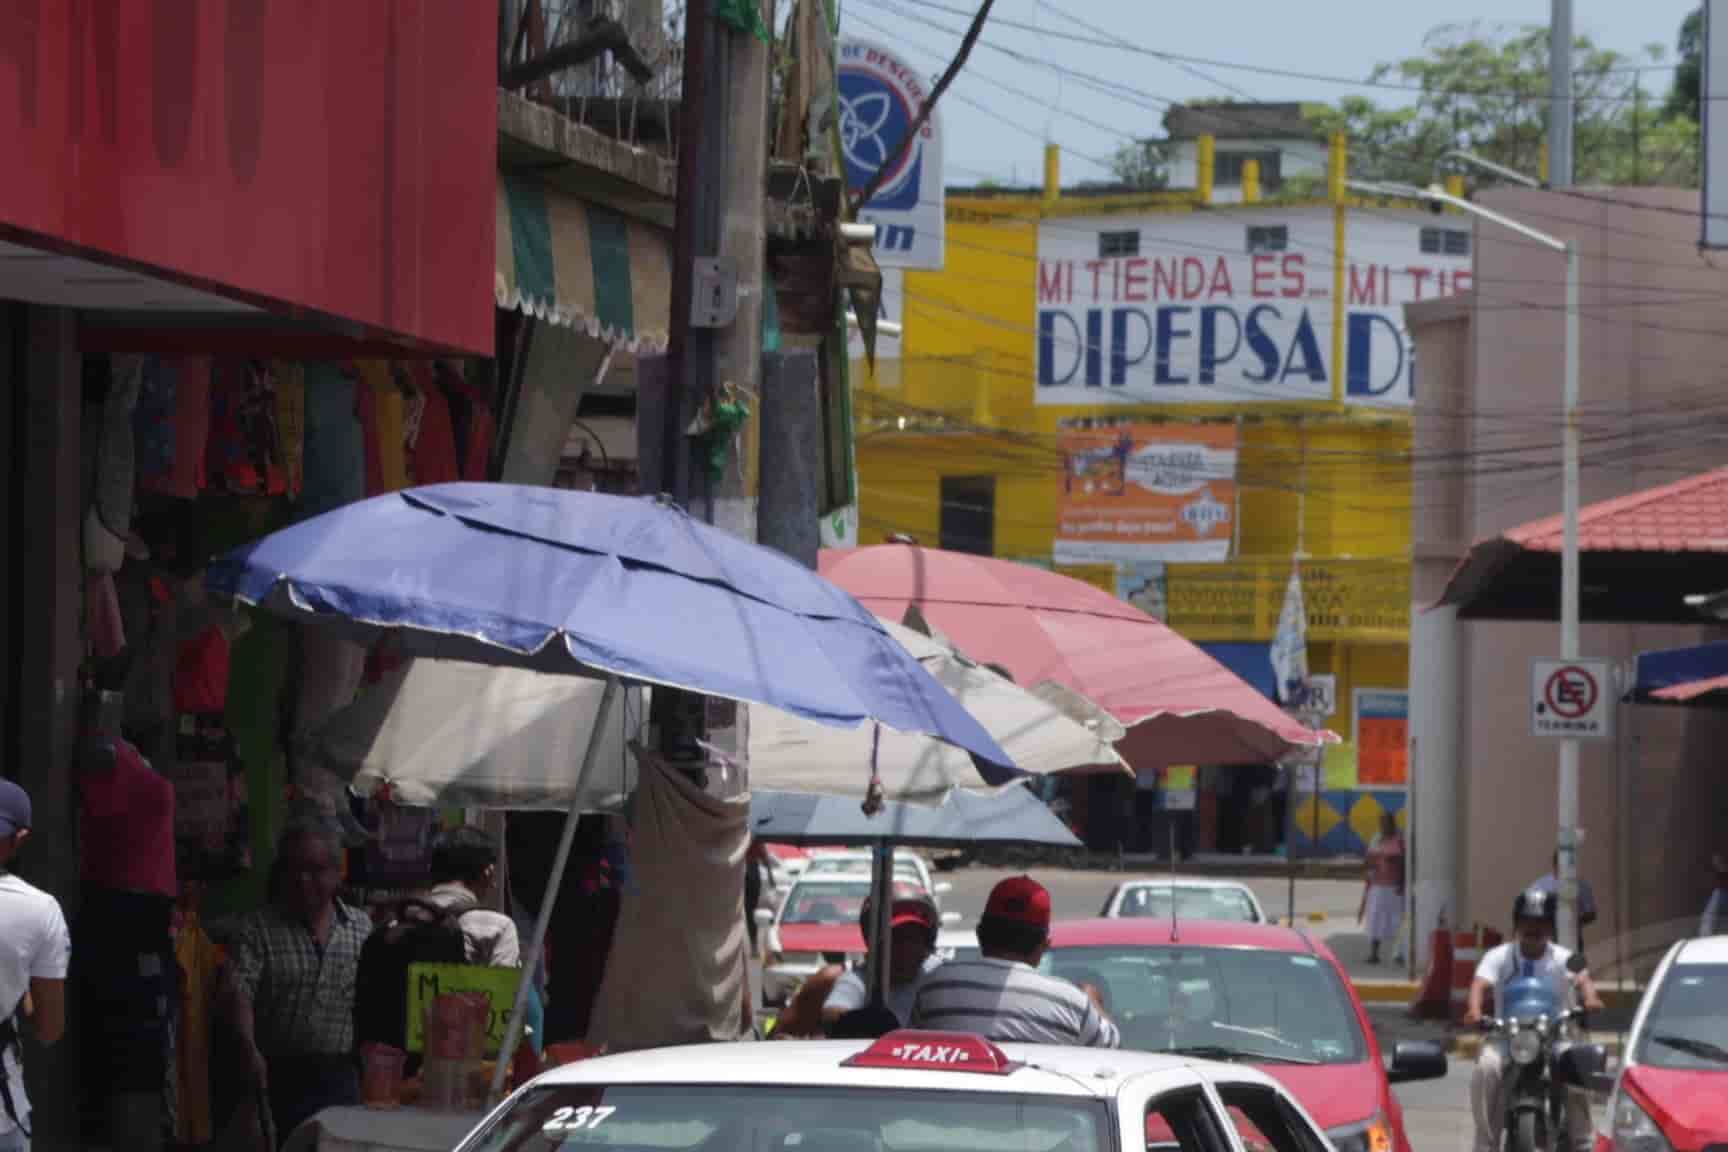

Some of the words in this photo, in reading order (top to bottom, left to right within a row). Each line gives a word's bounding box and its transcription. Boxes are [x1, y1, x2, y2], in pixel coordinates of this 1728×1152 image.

[1039, 258, 1072, 304] MI
[1088, 256, 1233, 303] TIENDA
[1348, 264, 1389, 305] MI
[1038, 304, 1327, 387] DIPEPSA
[902, 1043, 961, 1063] TAXI
[542, 1105, 617, 1130] 237
